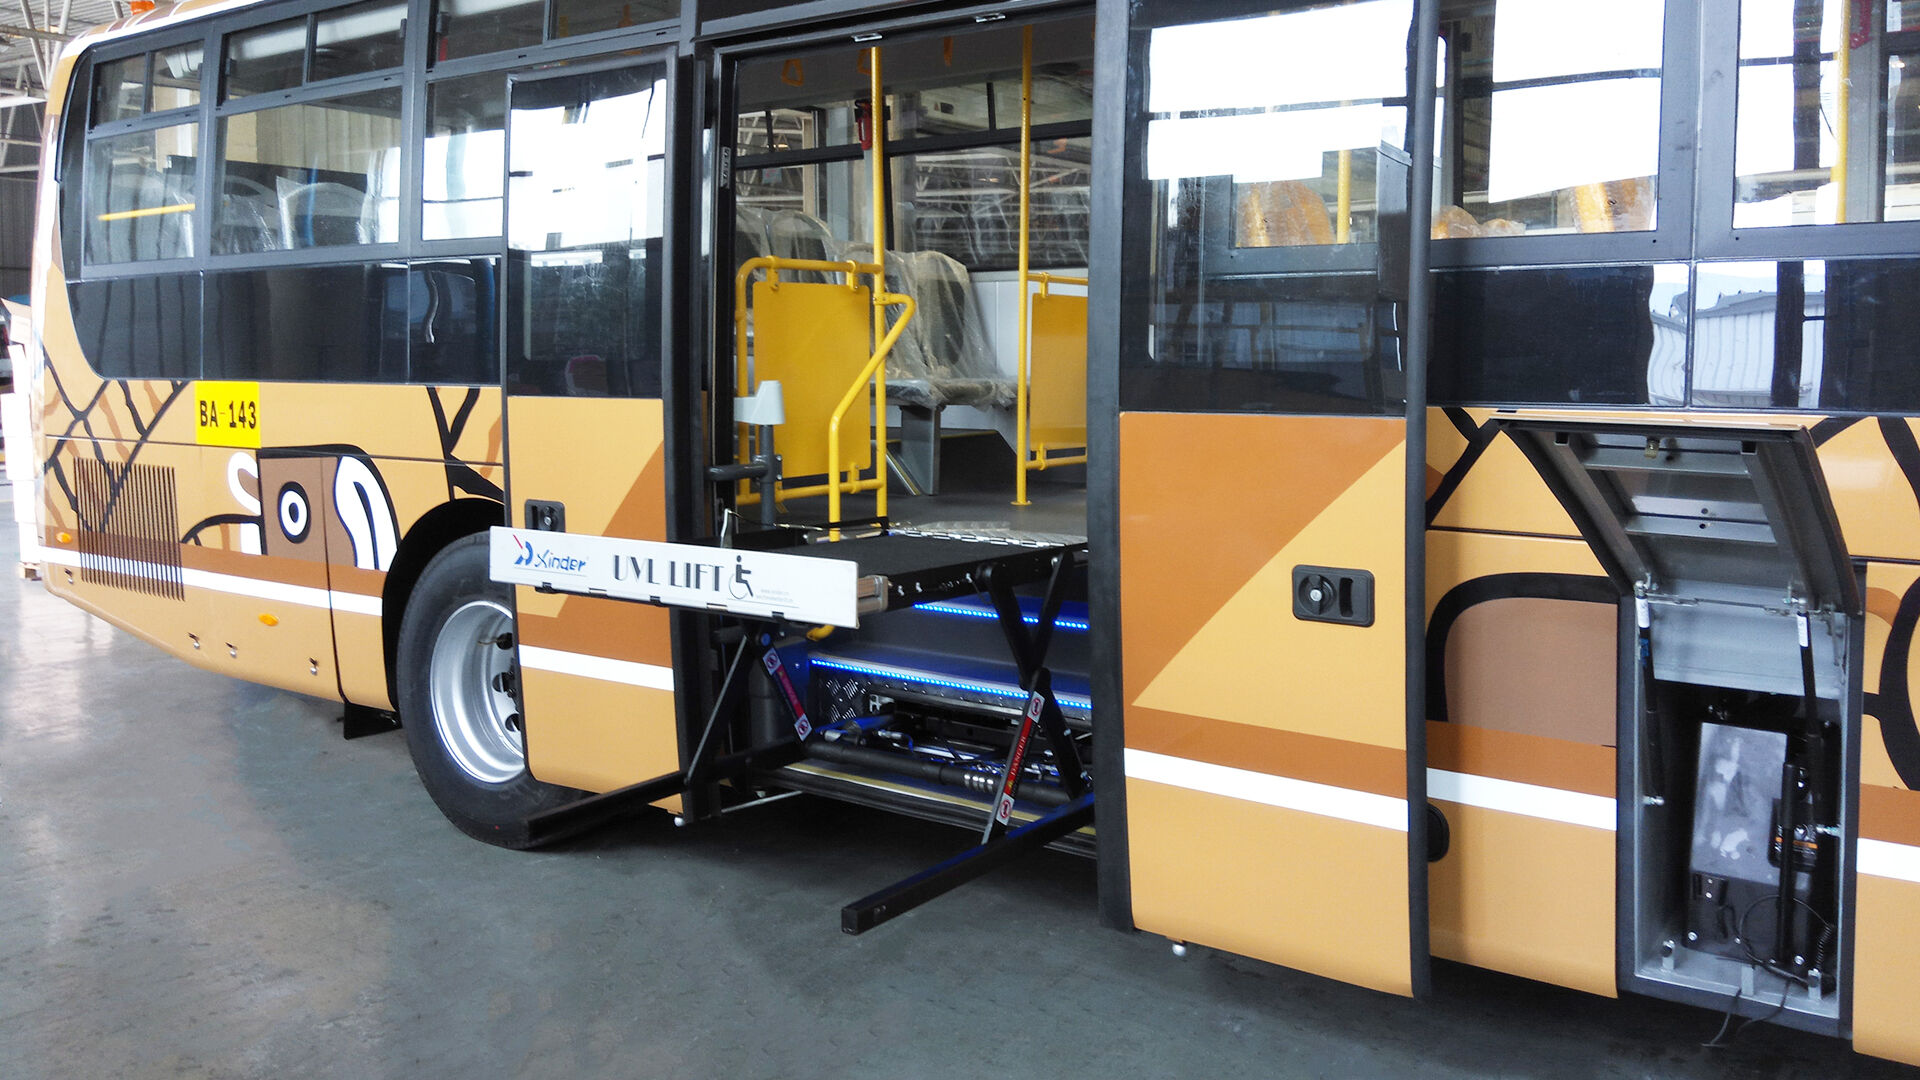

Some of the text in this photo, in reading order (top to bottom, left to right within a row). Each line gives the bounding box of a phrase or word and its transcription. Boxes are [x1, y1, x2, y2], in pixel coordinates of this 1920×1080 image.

[534, 549, 586, 572] Xinder
[614, 554, 725, 592] UVL LIFT
